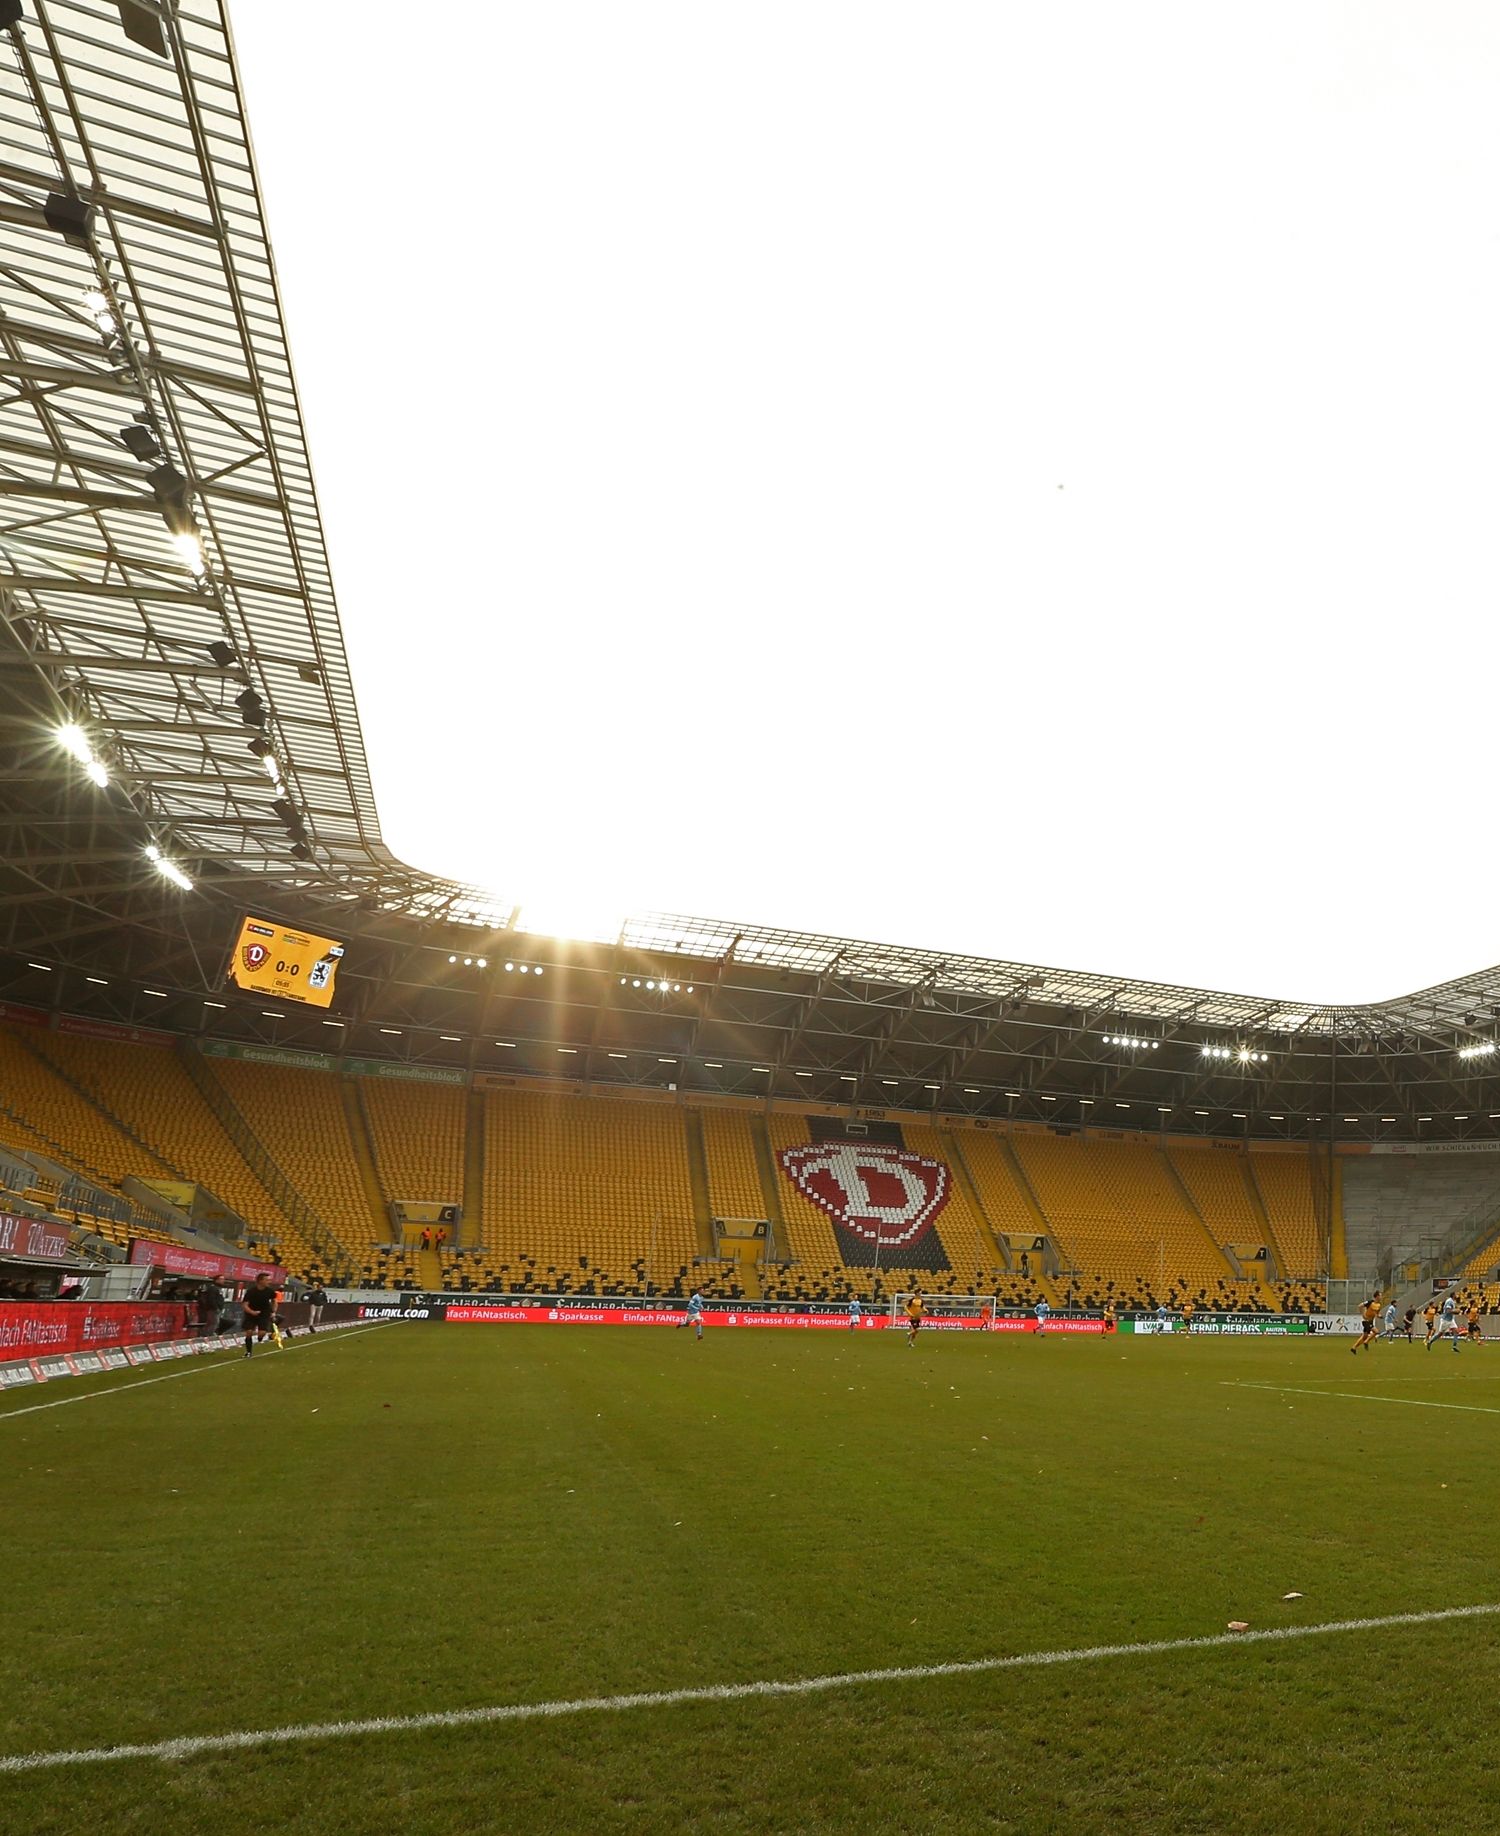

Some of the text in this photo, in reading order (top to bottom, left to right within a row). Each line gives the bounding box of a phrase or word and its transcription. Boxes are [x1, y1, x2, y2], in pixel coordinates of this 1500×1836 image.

[276, 960, 300, 976] 0:0
[242, 1049, 330, 1069] Gesundheitsblock
[378, 1066, 462, 1083] Gesundheitsblock
[444, 1210, 451, 1219] C
[472, 1310, 528, 1318] FANtastisch.
[560, 1312, 604, 1322] Sparkasse
[744, 1316, 782, 1325] Sparkasse
